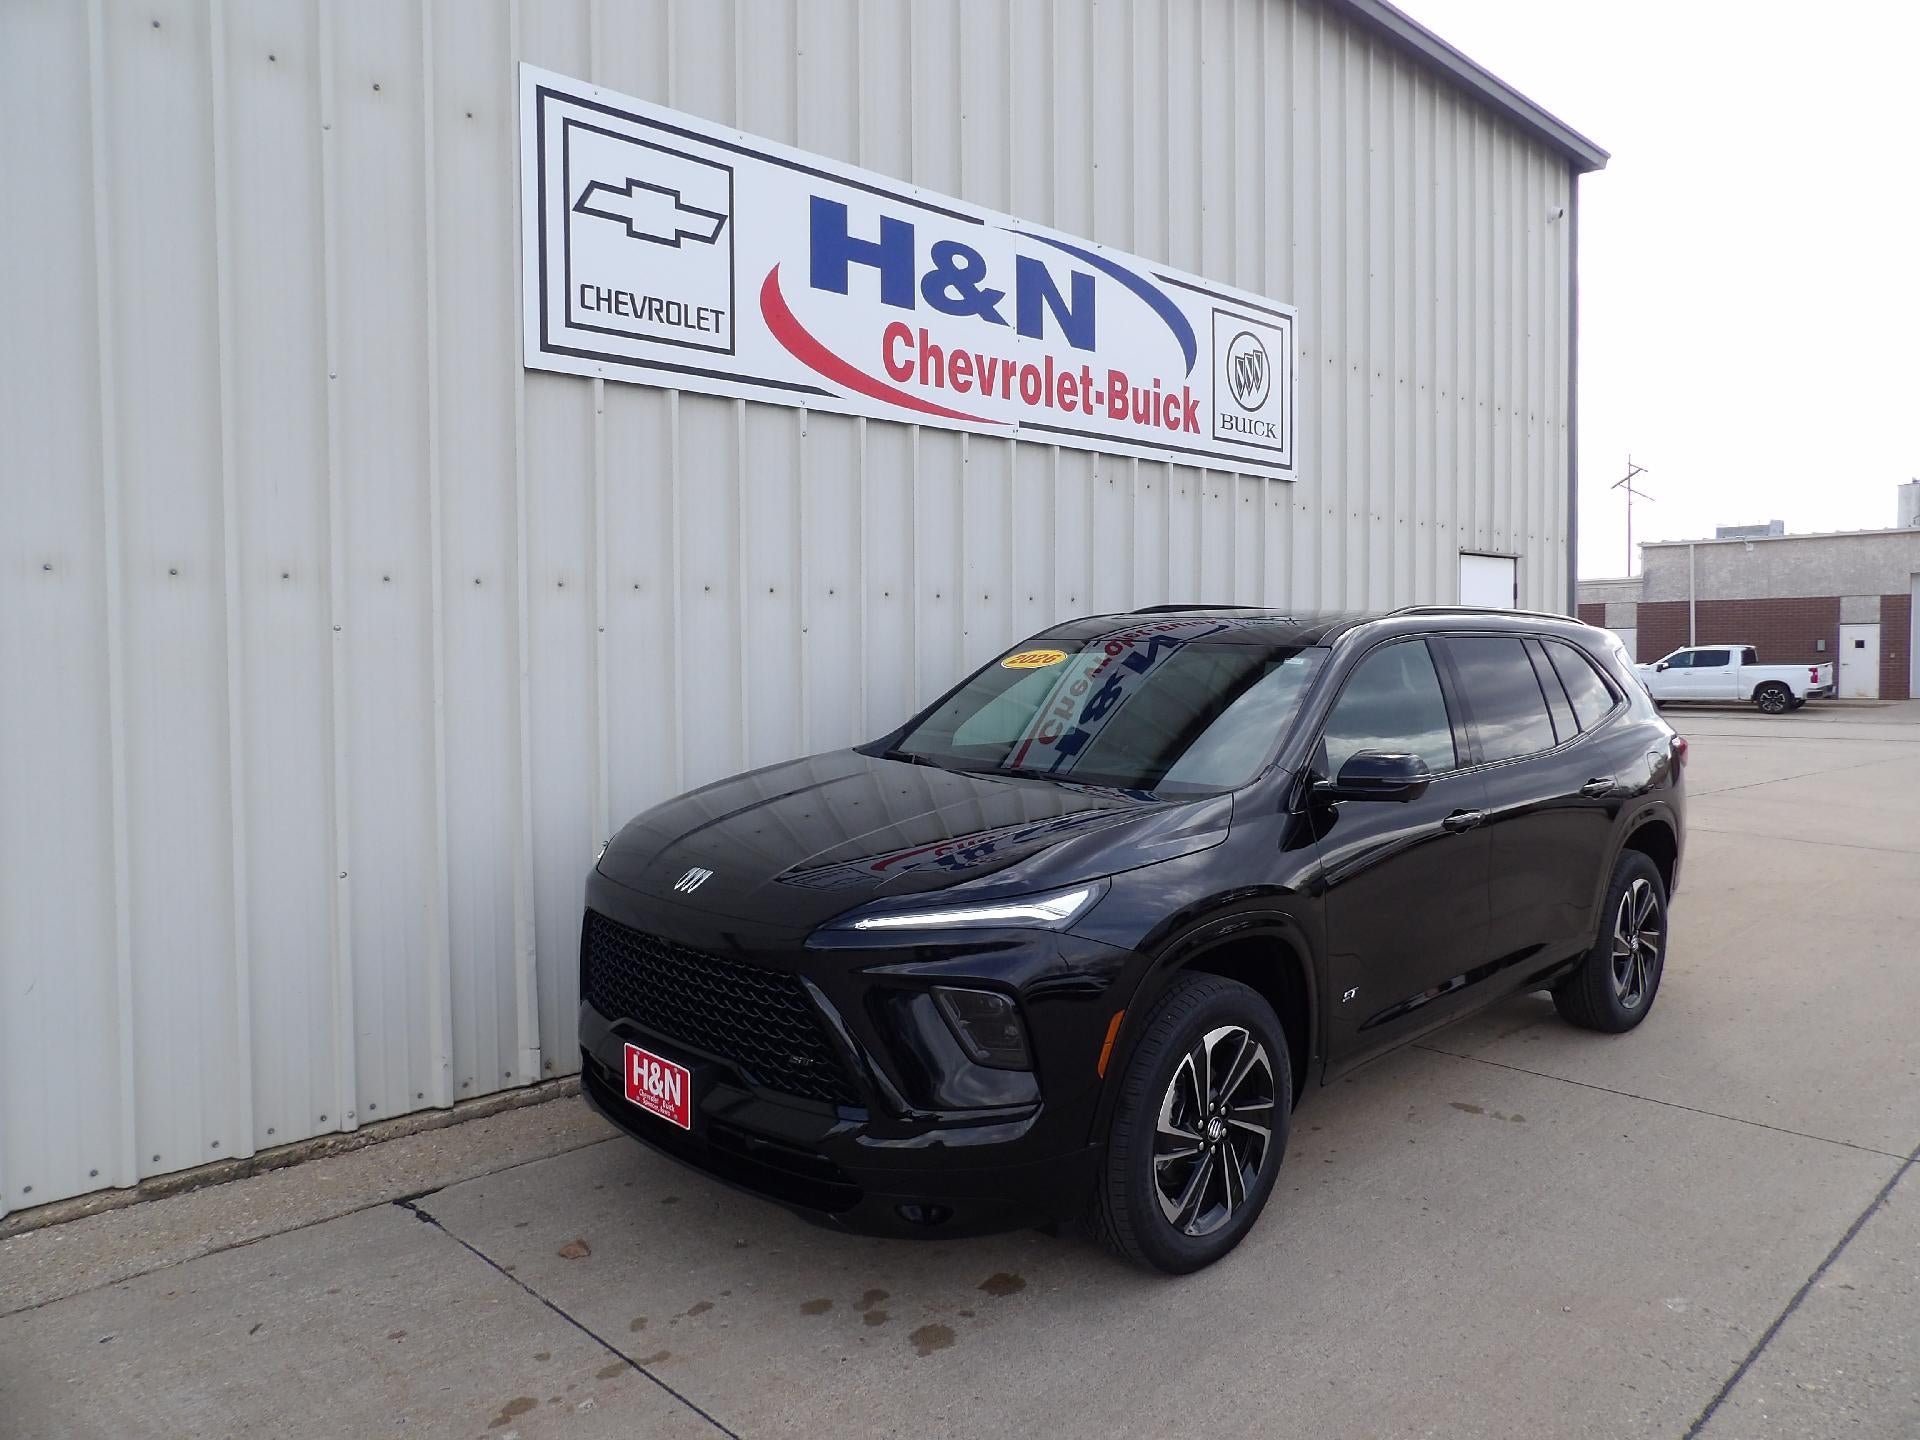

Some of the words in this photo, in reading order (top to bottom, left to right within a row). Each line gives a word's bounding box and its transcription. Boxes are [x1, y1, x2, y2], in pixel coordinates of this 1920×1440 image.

[809, 194, 1096, 352] H&N
[580, 283, 725, 334] CHEVROLET
[882, 321, 1201, 434] Chevrolet-Buick
[1220, 412, 1278, 439] BUICK
[1005, 653, 1062, 665] 2026
[633, 1054, 681, 1107] H&N
